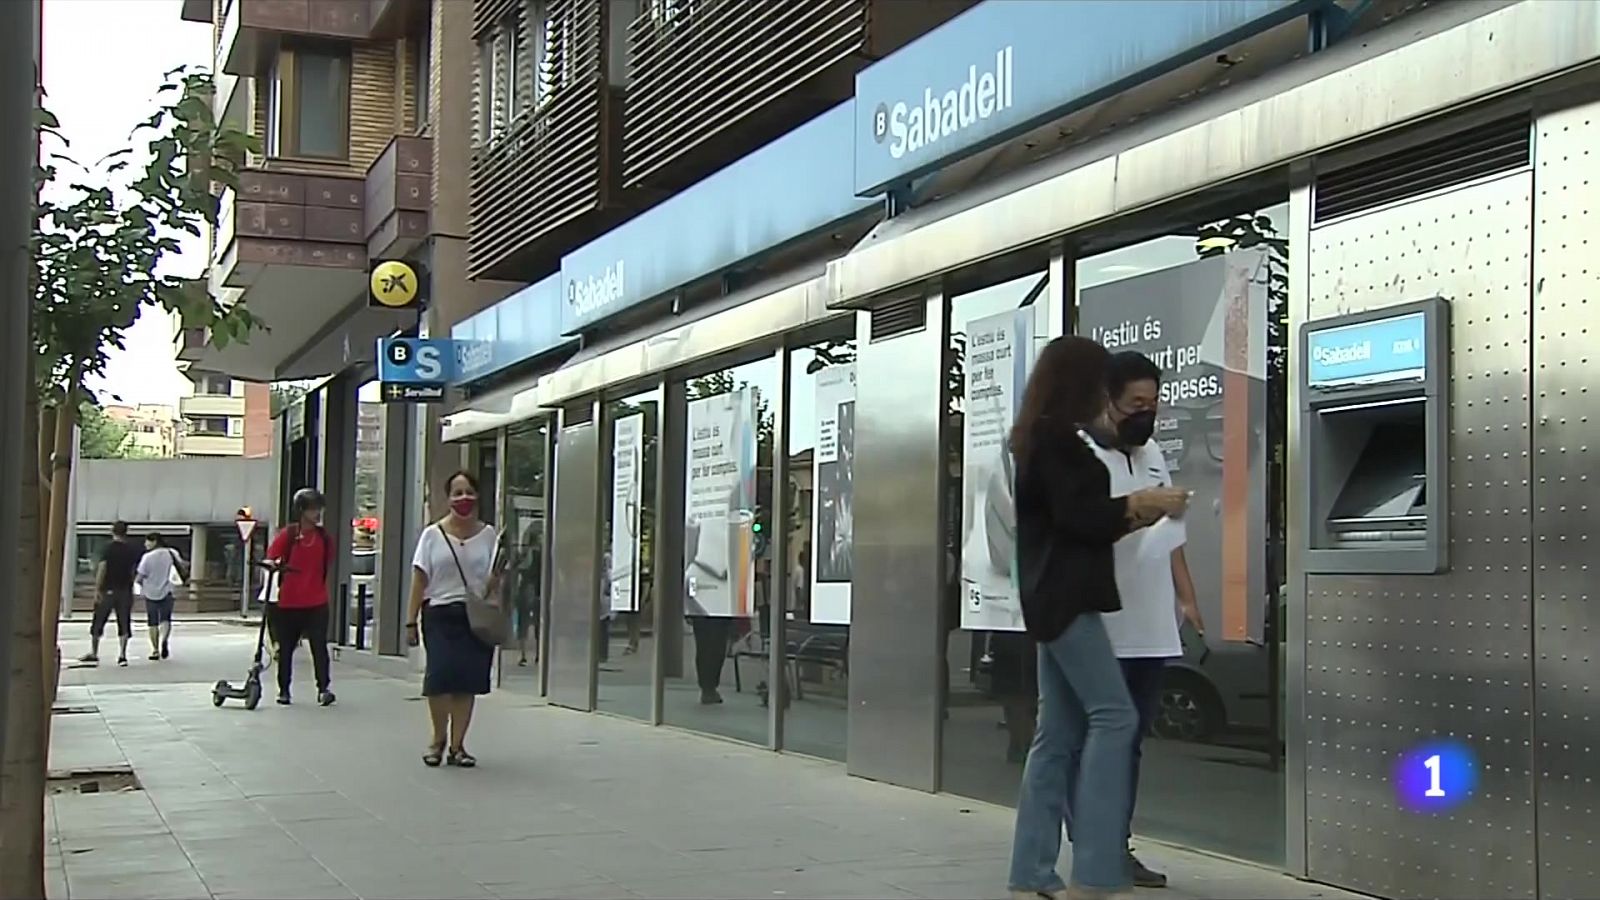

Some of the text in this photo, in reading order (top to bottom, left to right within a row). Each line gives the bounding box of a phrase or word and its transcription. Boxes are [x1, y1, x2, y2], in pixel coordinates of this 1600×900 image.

[876, 46, 1013, 159] B Sabadell
[575, 259, 624, 317] Sabadell
[1144, 315, 1161, 341] és
[394, 346, 407, 361] B
[415, 346, 441, 379] S
[1145, 344, 1202, 374] urt per
[1320, 341, 1372, 367] Sabadell
[1158, 374, 1223, 406] speses.
